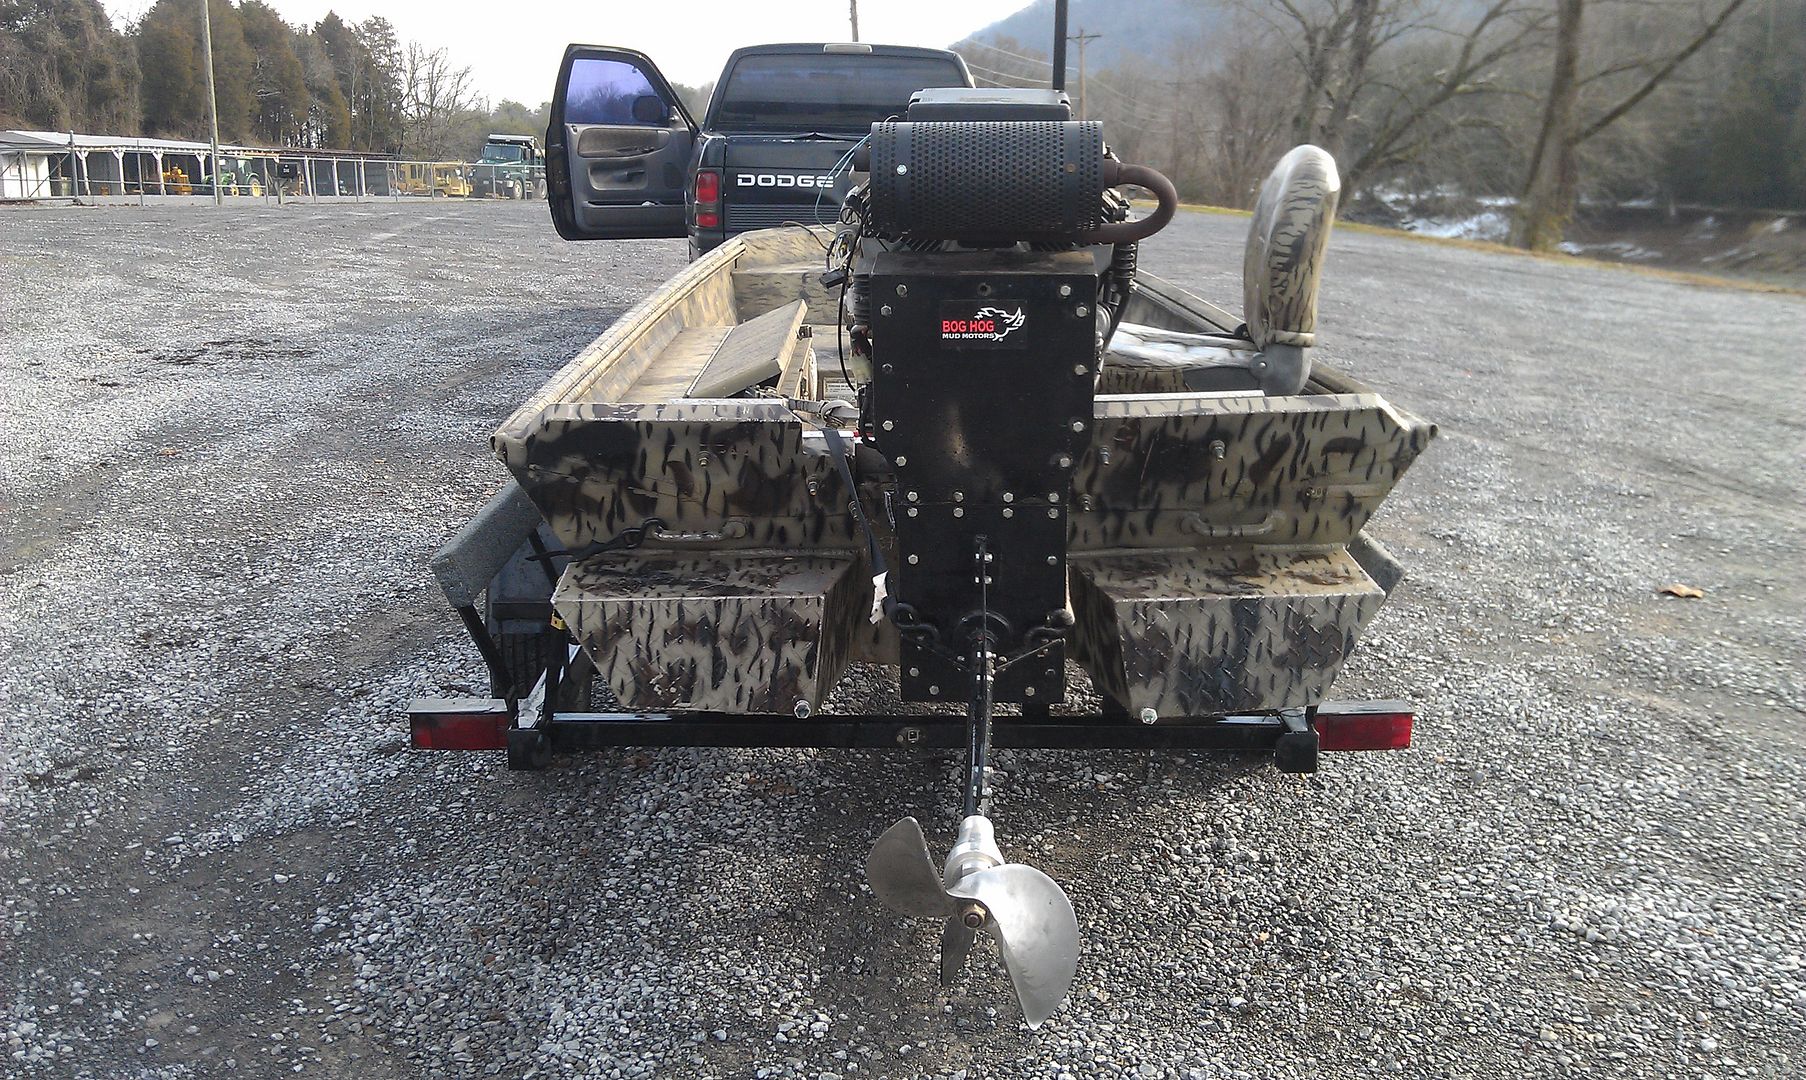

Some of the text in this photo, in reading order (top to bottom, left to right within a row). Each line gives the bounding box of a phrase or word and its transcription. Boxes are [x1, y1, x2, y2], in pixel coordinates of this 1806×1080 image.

[737, 174, 834, 188] DODGE
[942, 320, 995, 332] BOG HOG
